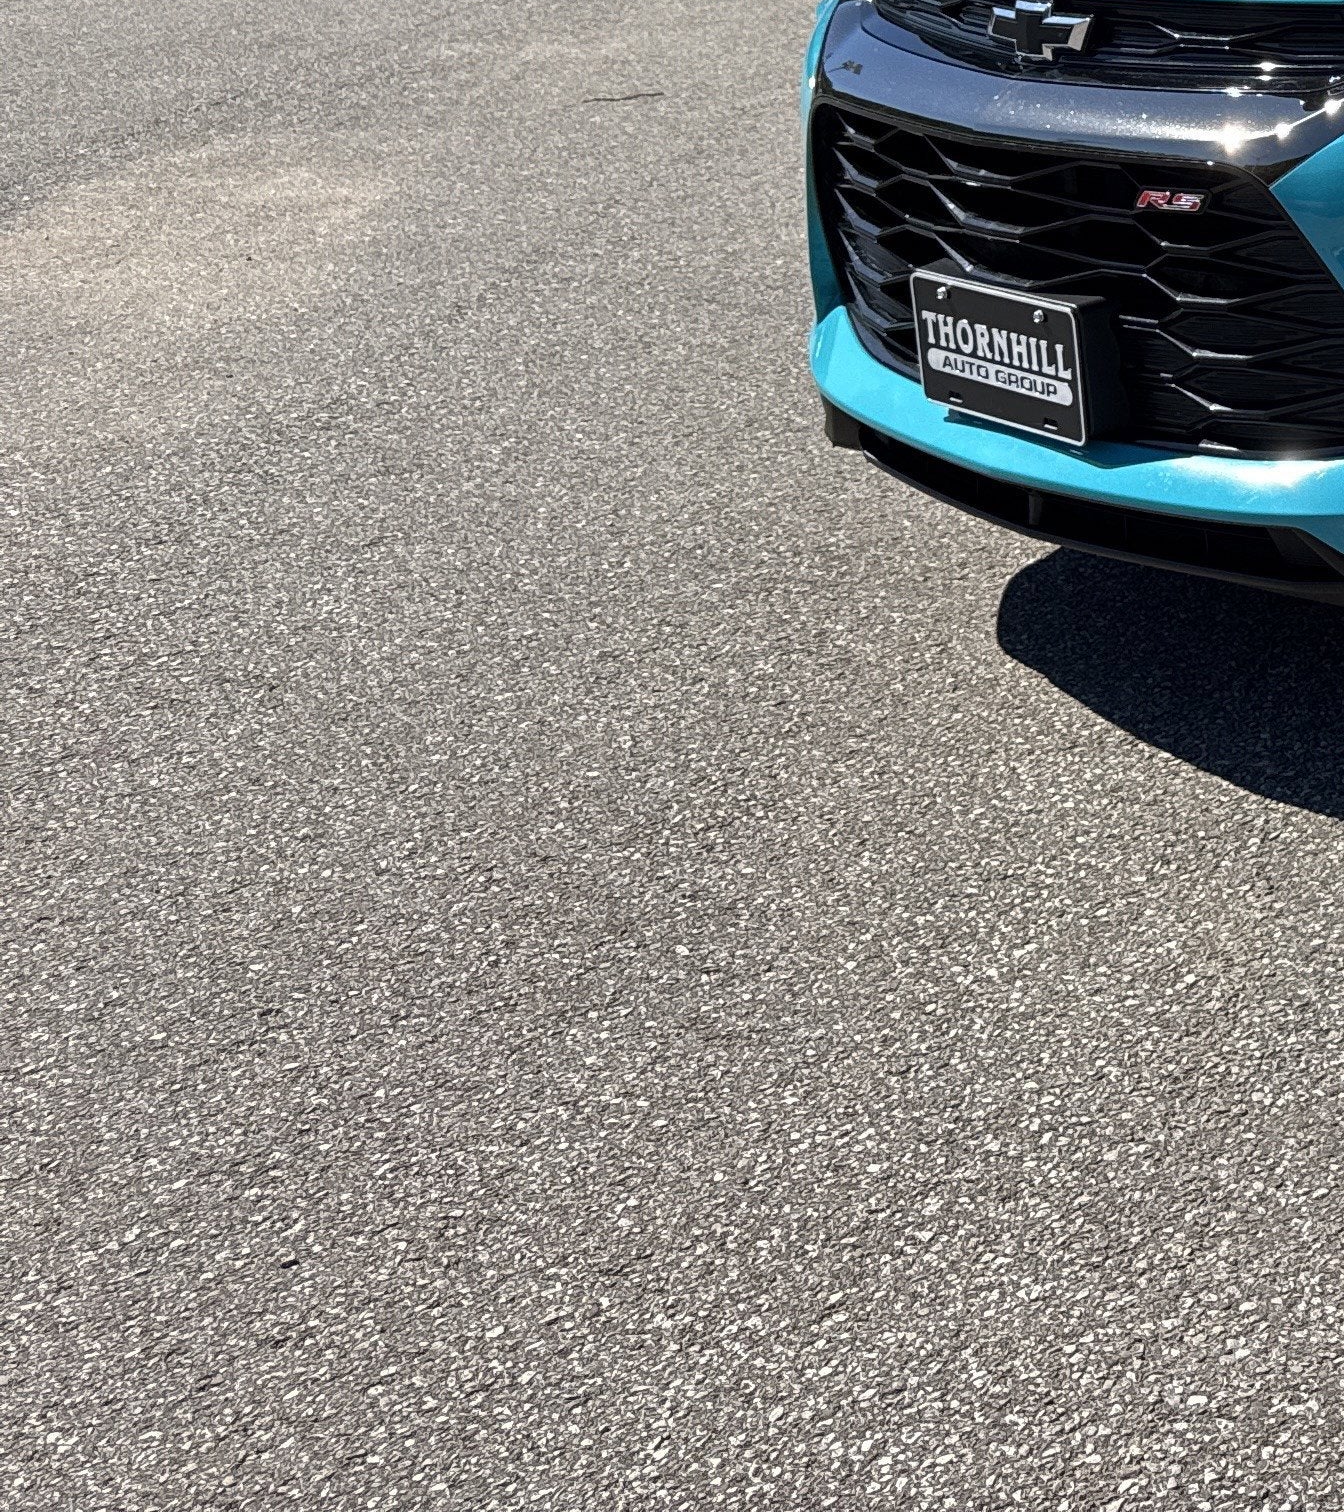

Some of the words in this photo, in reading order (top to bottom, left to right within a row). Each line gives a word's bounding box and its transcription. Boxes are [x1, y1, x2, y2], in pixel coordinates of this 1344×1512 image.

[1136, 190, 1205, 212] RS
[921, 310, 1072, 380] THORNHILL
[942, 355, 989, 380] AUTO
[995, 369, 1058, 398] GROUP
